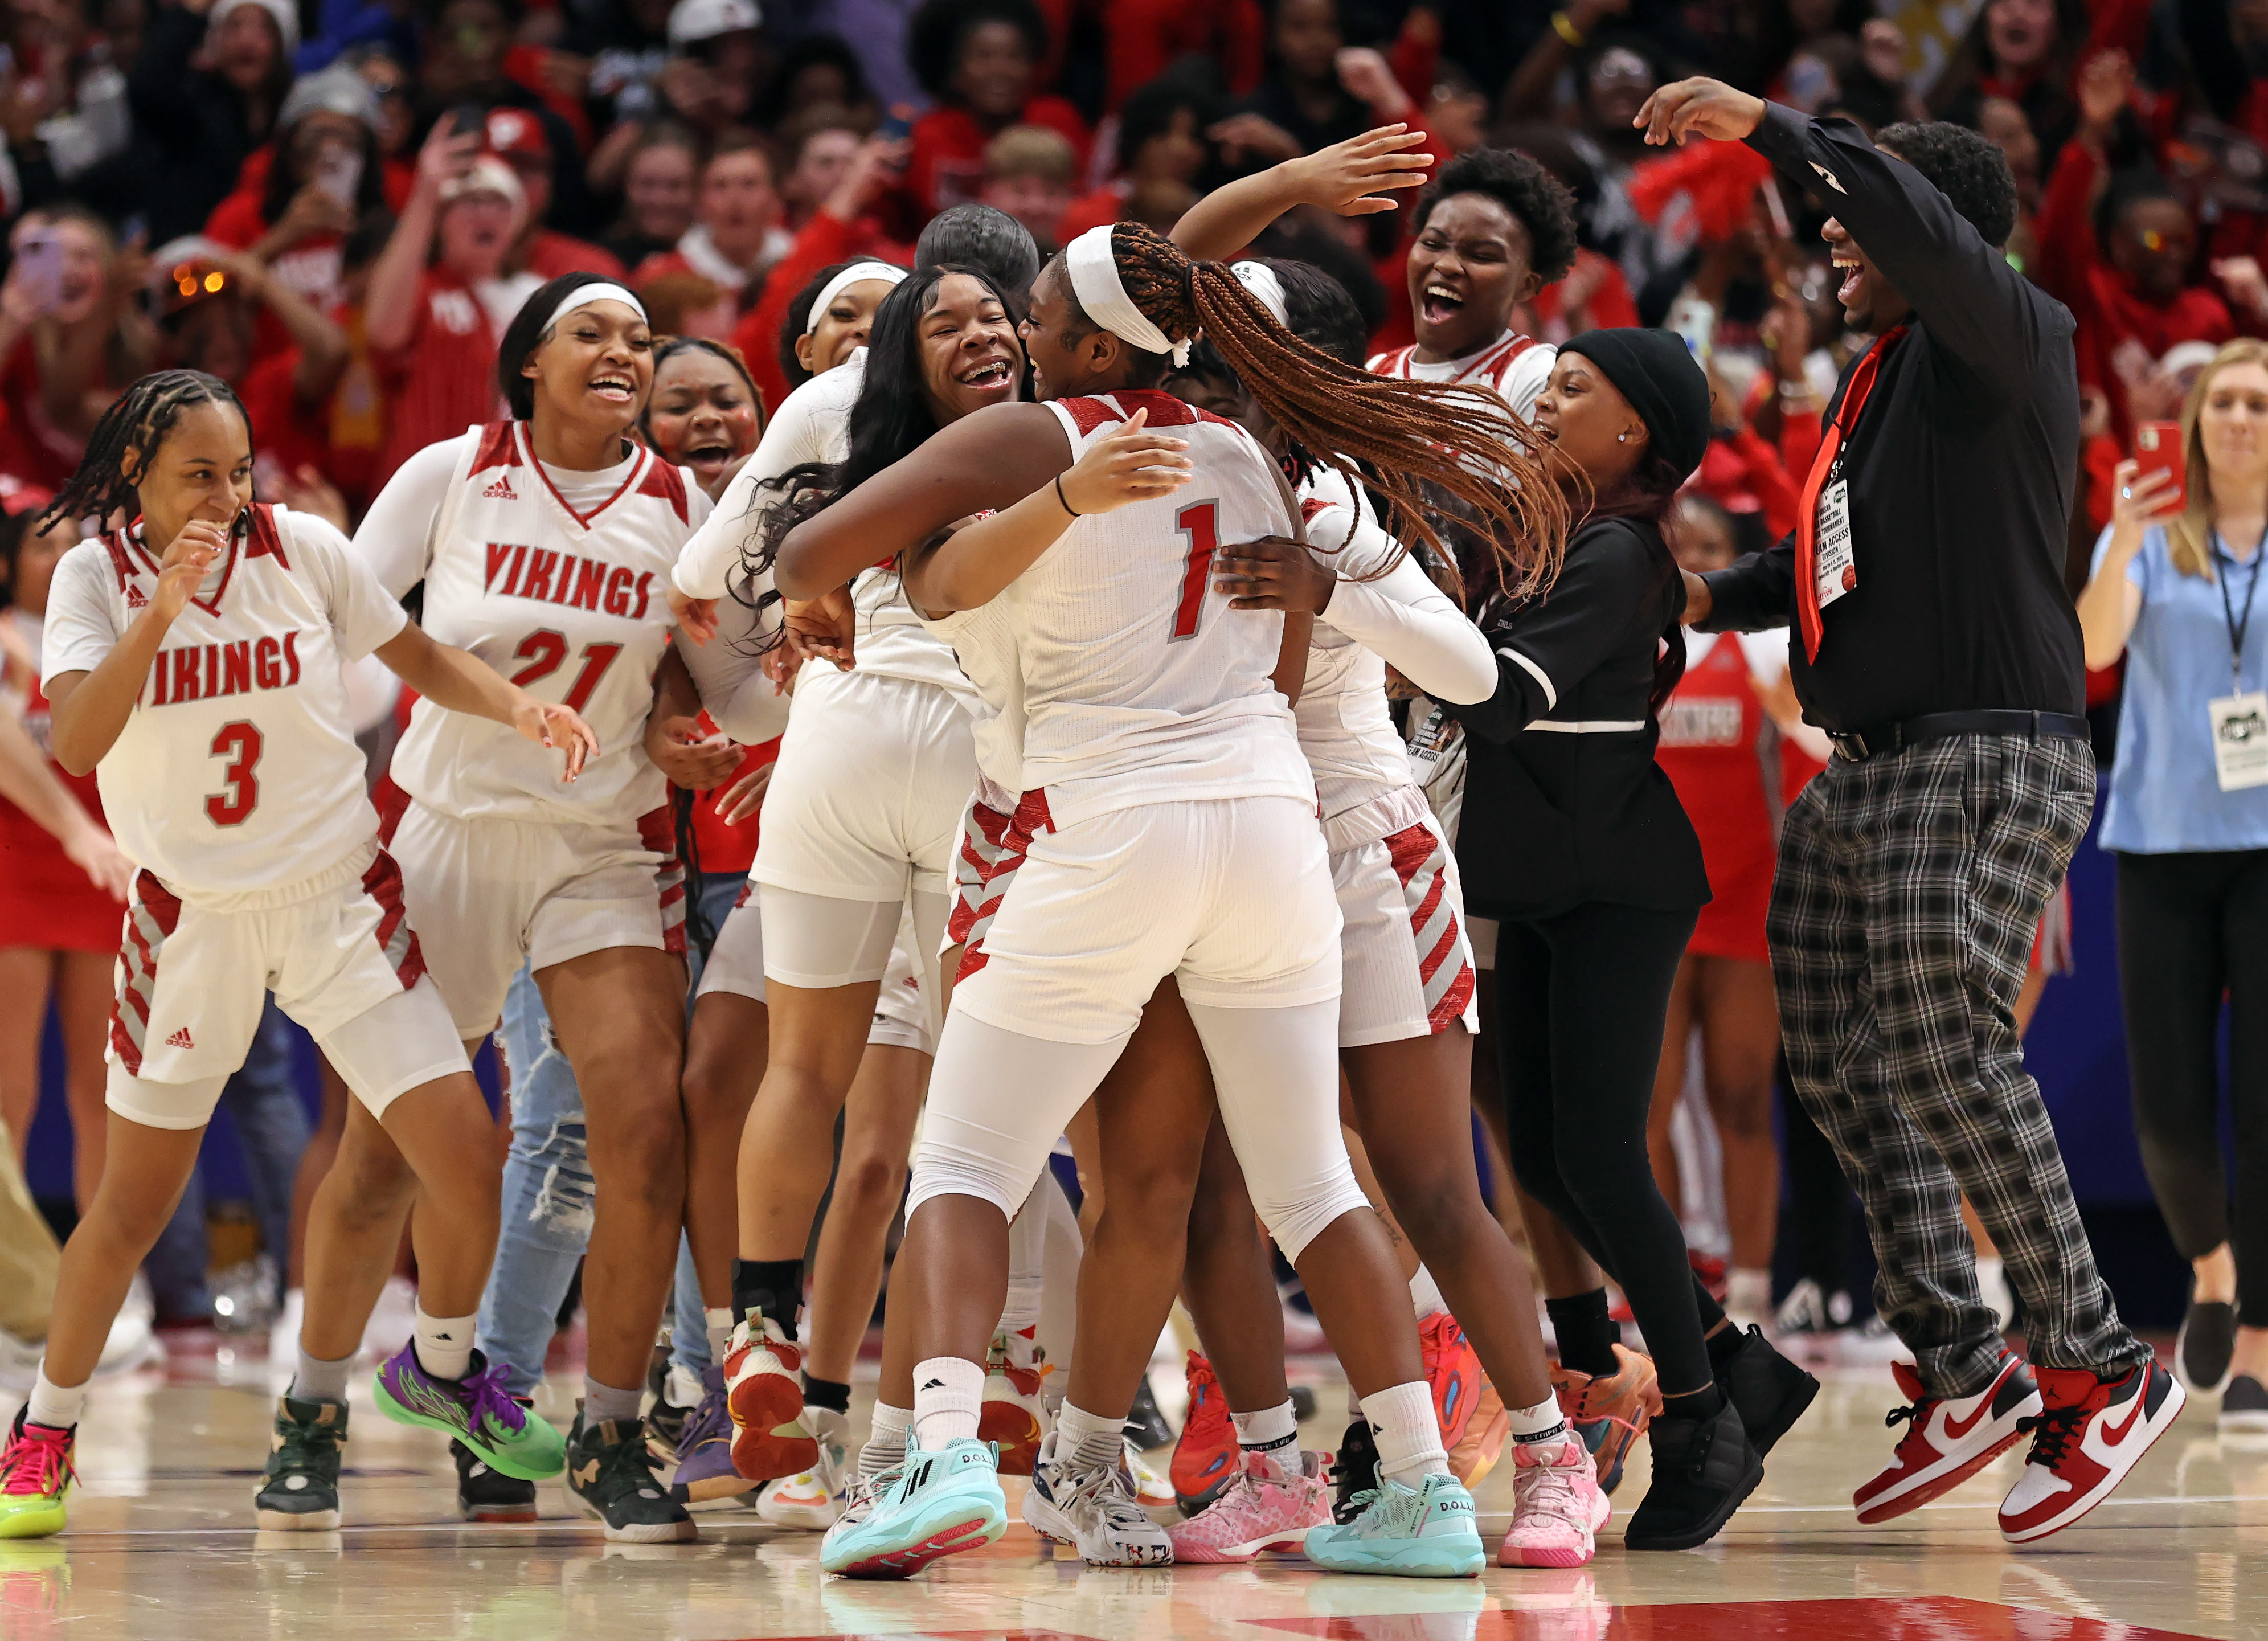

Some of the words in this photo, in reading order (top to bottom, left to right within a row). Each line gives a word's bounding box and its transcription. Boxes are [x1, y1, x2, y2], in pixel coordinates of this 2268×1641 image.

[483, 488, 518, 500] adidas
[1829, 527, 1849, 547] ACCESS
[1822, 546, 1839, 561] DIVISION
[483, 542, 657, 620] VIKINGS
[1167, 498, 1222, 644] 1
[1819, 588, 1833, 602] drive
[1497, 619, 1513, 629] GIRLS
[136, 629, 301, 713] IKINGS
[510, 627, 625, 714] 21
[1407, 745, 1420, 758] TEAM
[1419, 750, 1440, 762] ACCESS
[203, 719, 264, 829] 3
